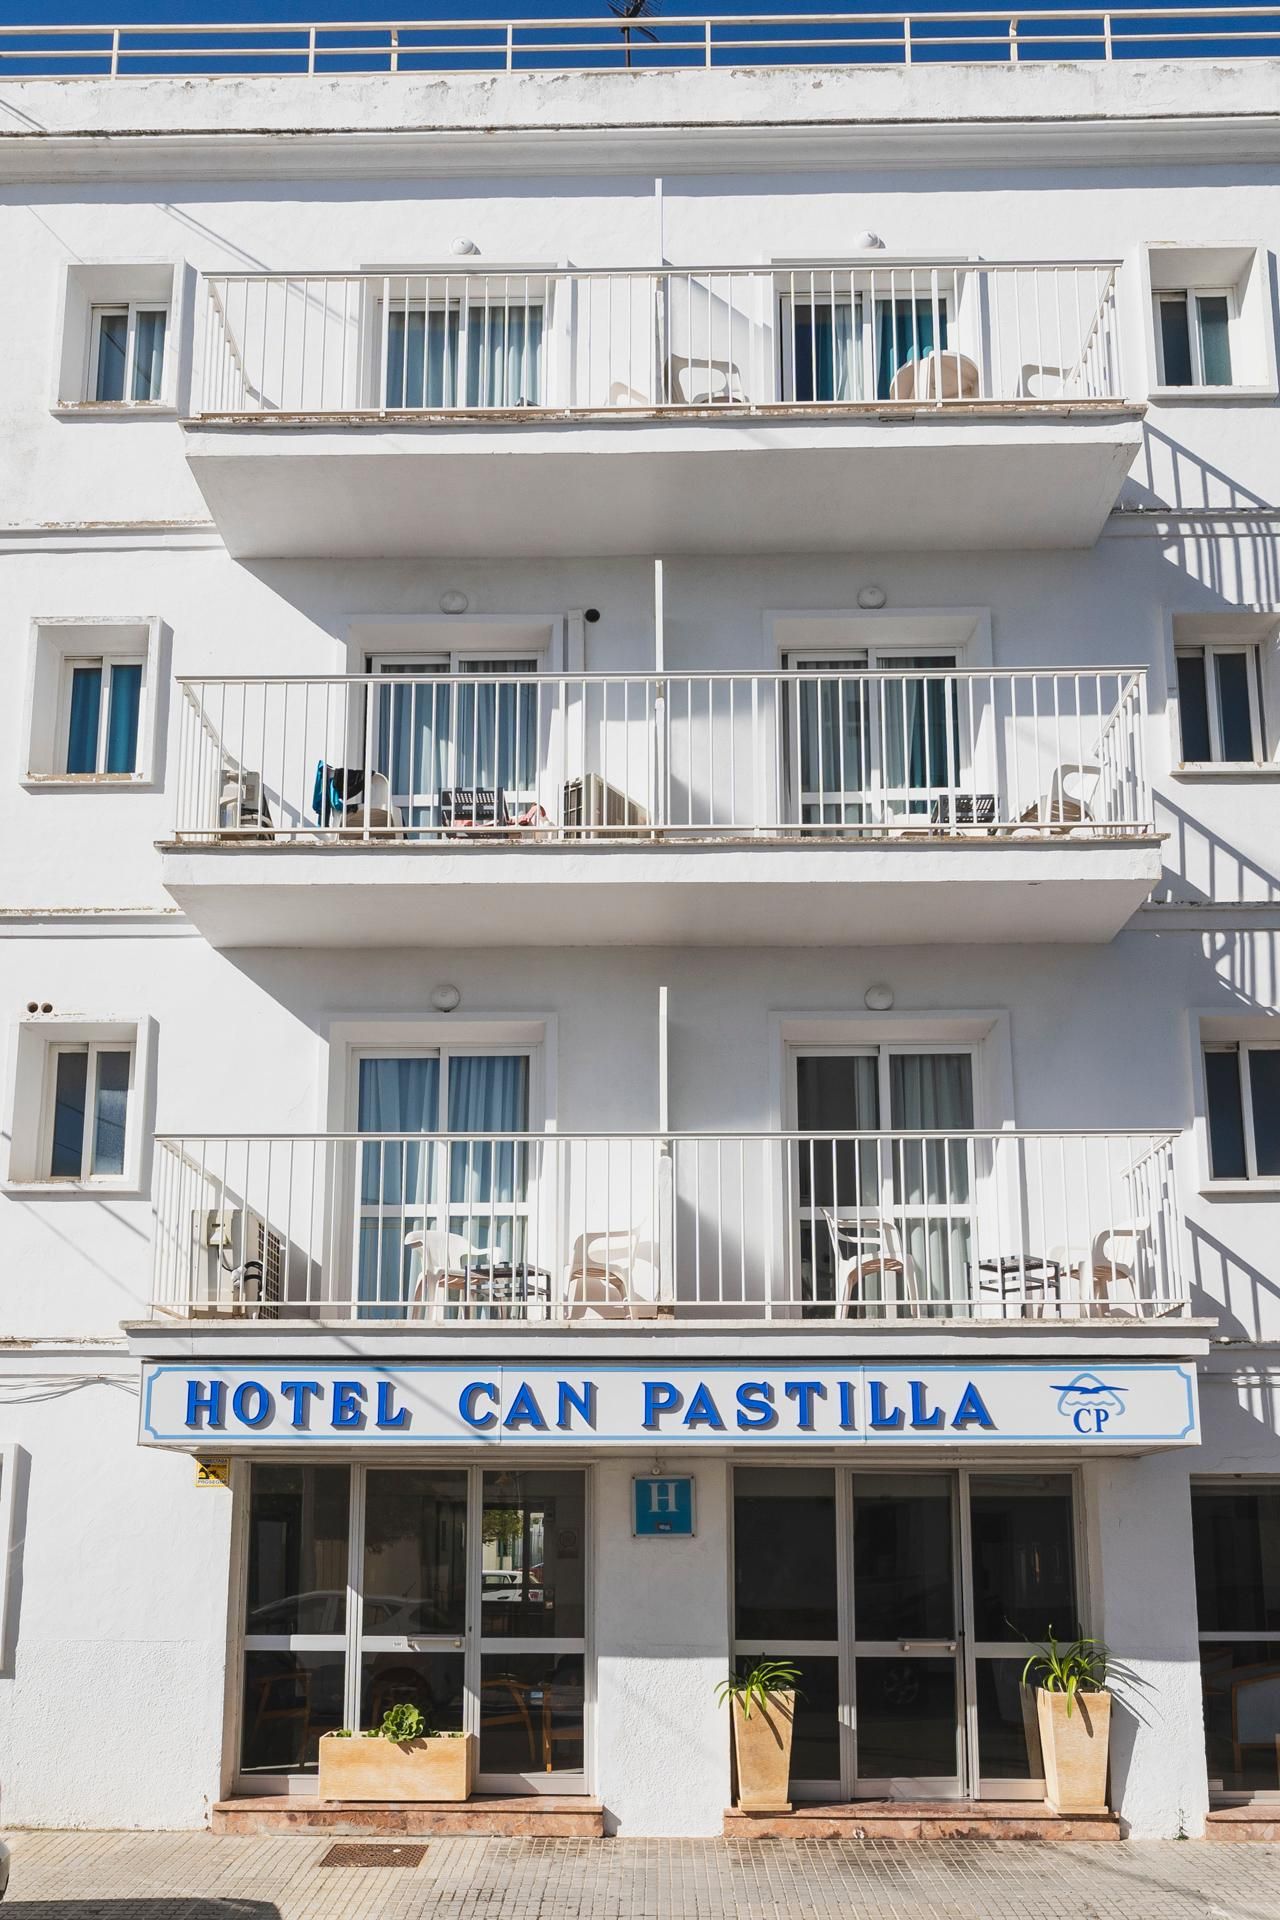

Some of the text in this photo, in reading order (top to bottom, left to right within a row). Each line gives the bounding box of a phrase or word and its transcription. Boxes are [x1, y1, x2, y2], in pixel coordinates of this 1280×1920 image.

[185, 1380, 993, 1428] HOTEL CAN PASTILLA
[1073, 1407, 1109, 1433] CP
[648, 1482, 680, 1512] H
